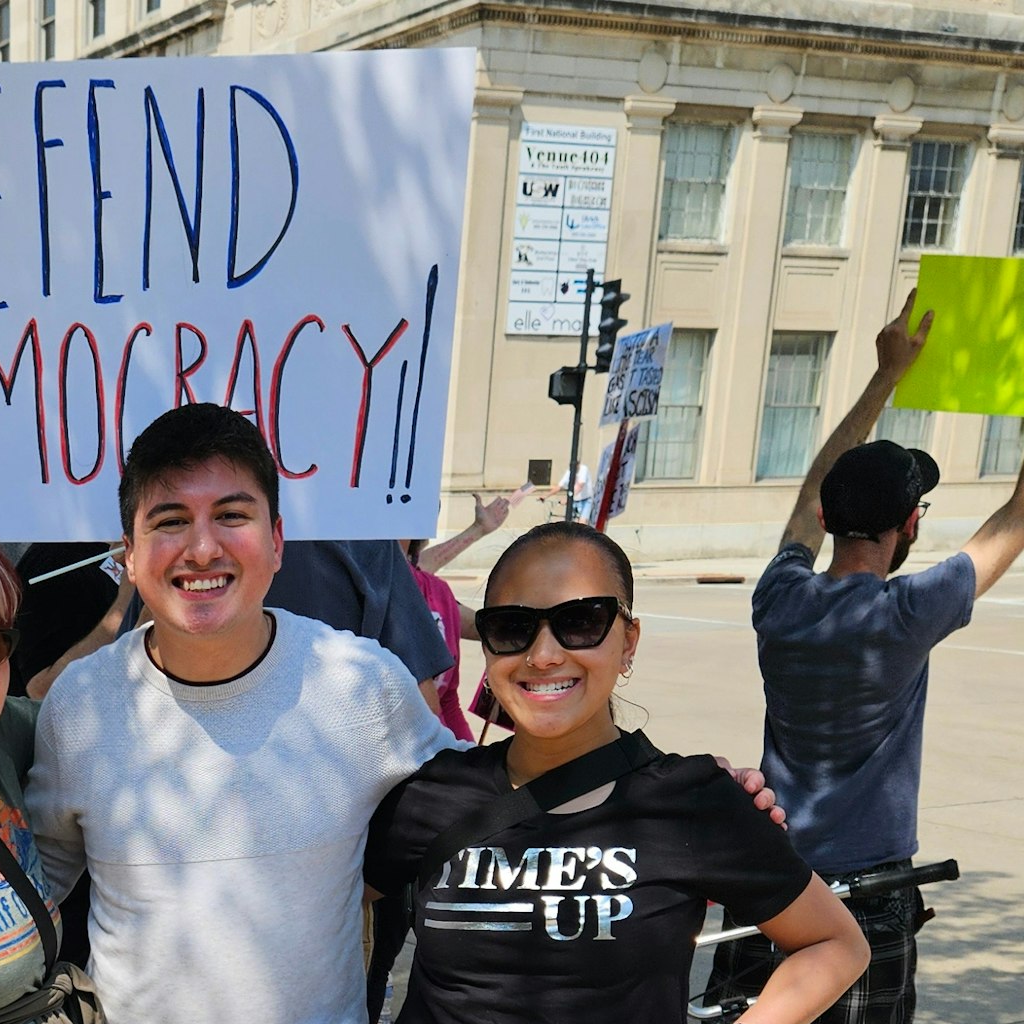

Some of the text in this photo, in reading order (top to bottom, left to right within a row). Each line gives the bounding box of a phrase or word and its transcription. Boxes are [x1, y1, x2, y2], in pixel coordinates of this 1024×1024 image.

[546, 129, 579, 139] National
[580, 131, 612, 142] Building
[540, 894, 634, 941] UP
